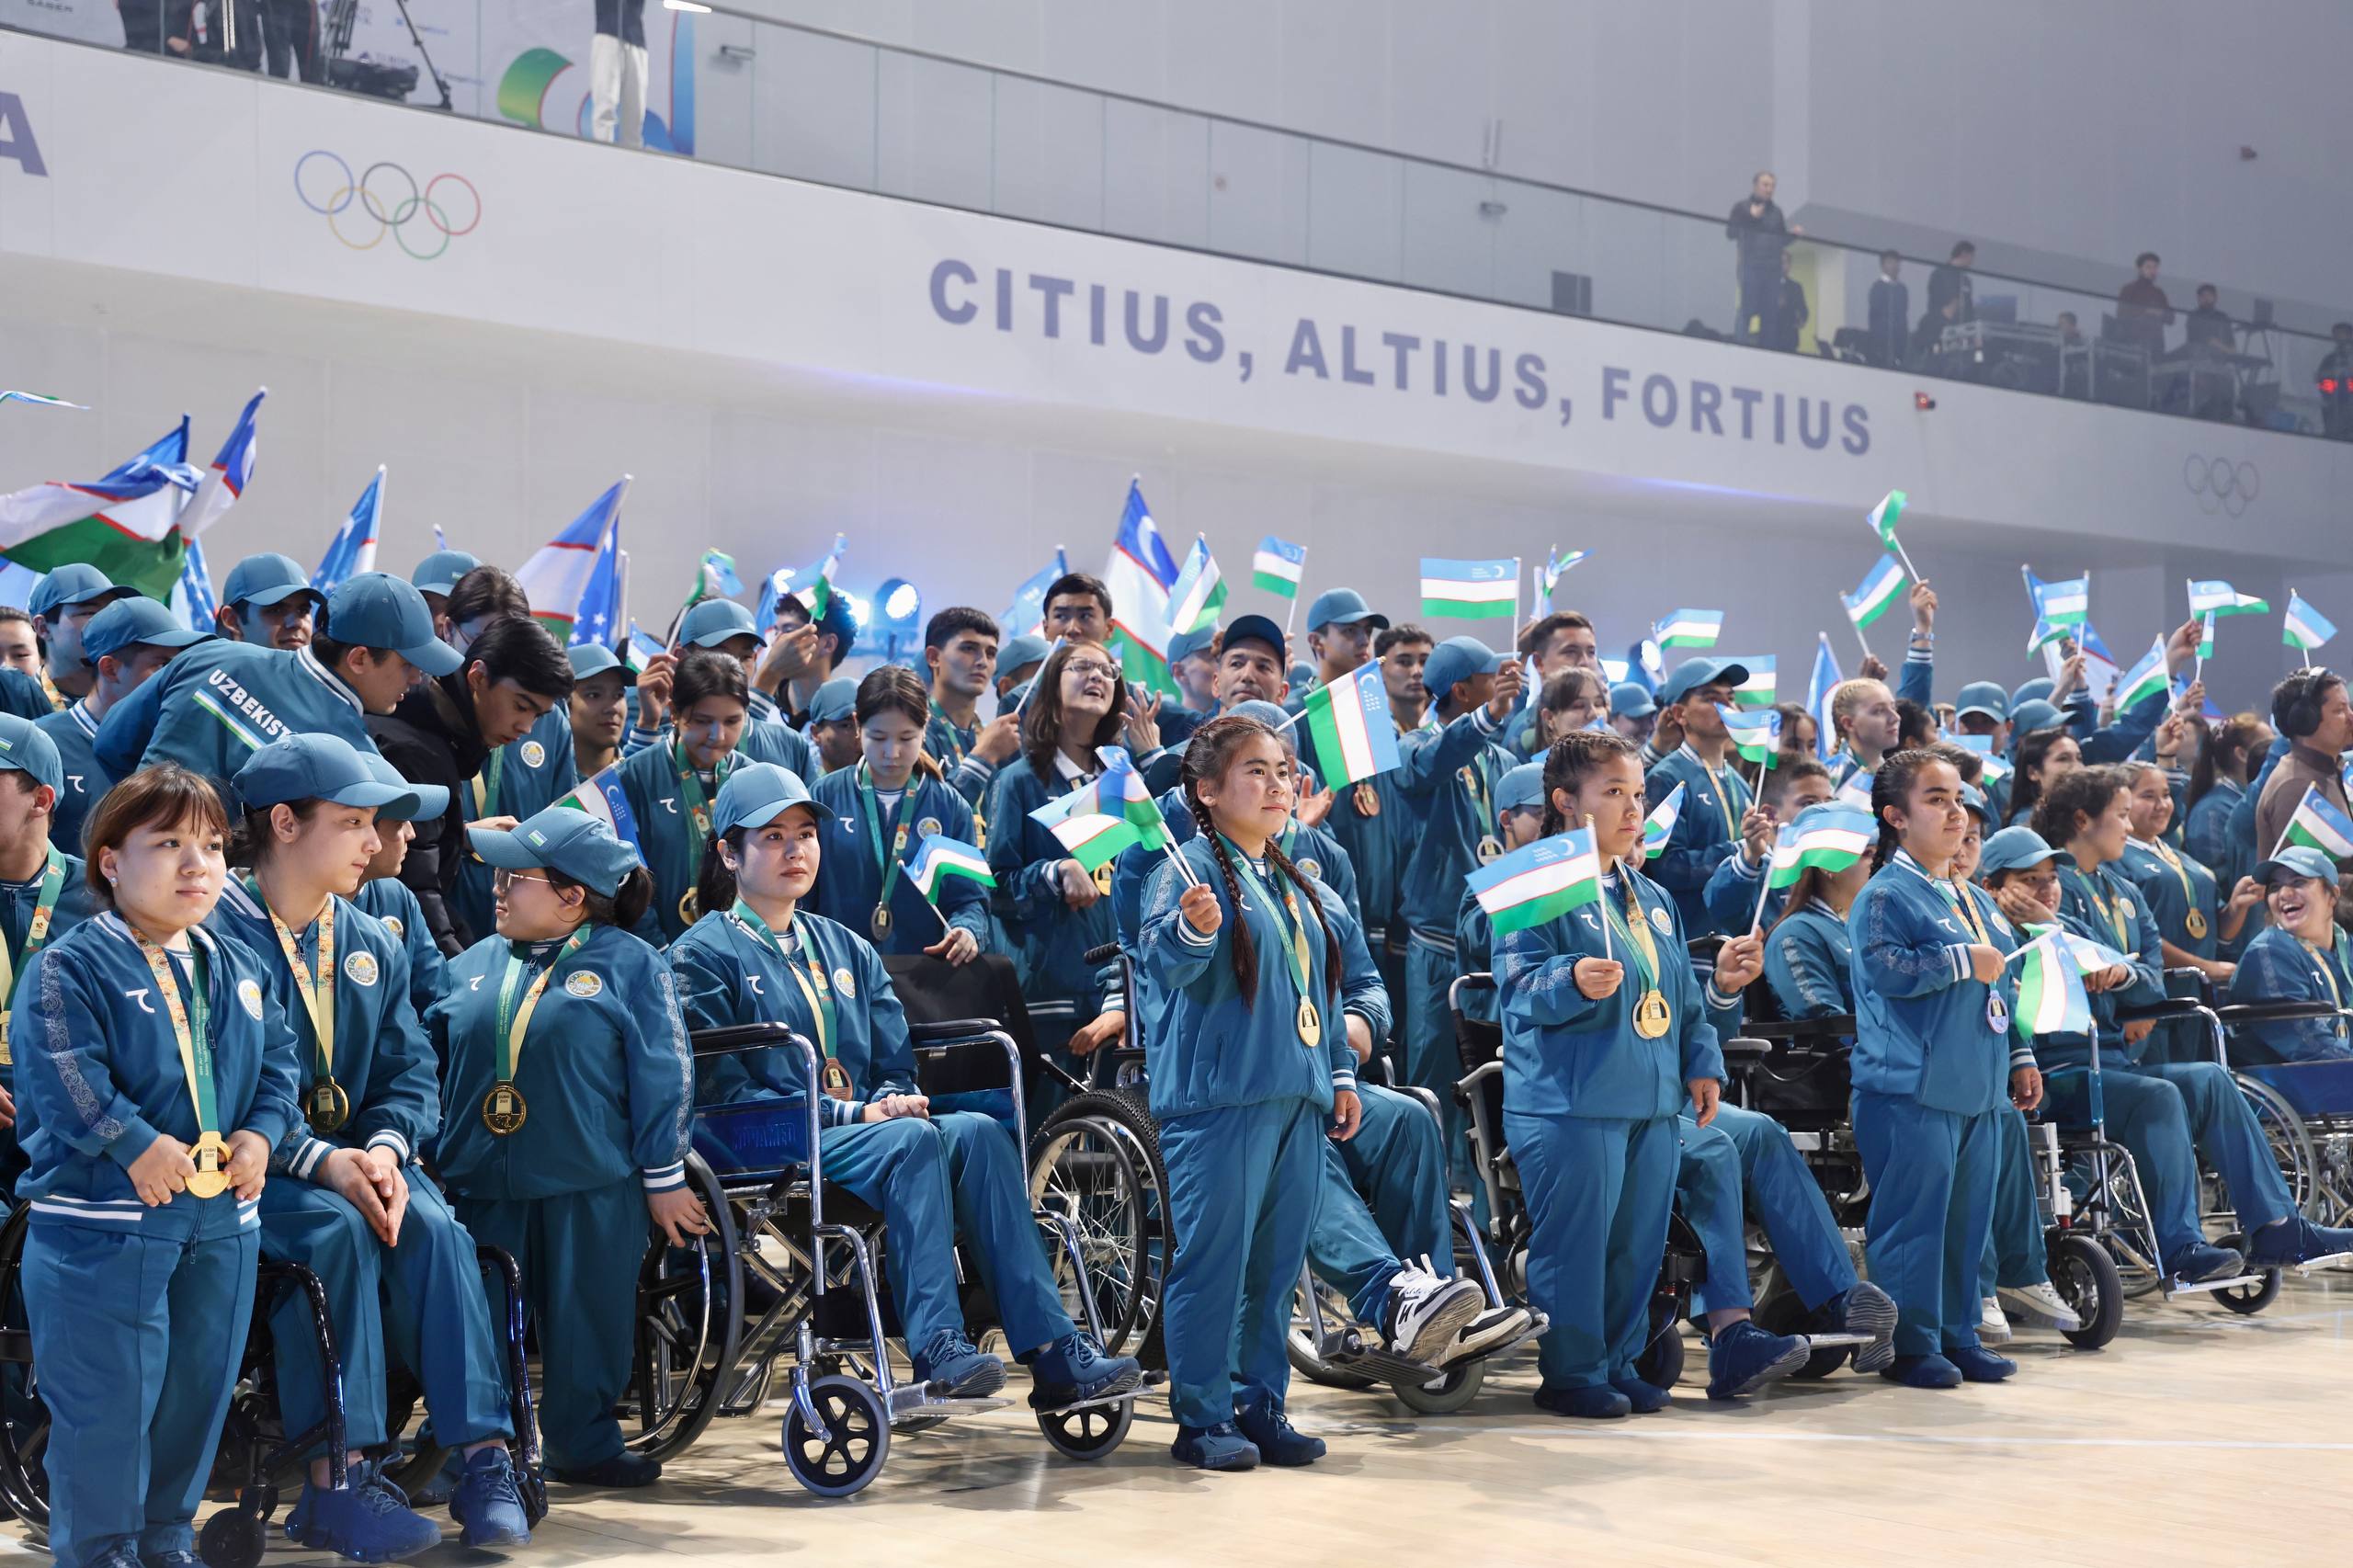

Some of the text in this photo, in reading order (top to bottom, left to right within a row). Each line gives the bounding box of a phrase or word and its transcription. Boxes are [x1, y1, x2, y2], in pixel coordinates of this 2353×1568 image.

[930, 259, 1870, 458] CITIUS, ALTIUS, FORTIUS
